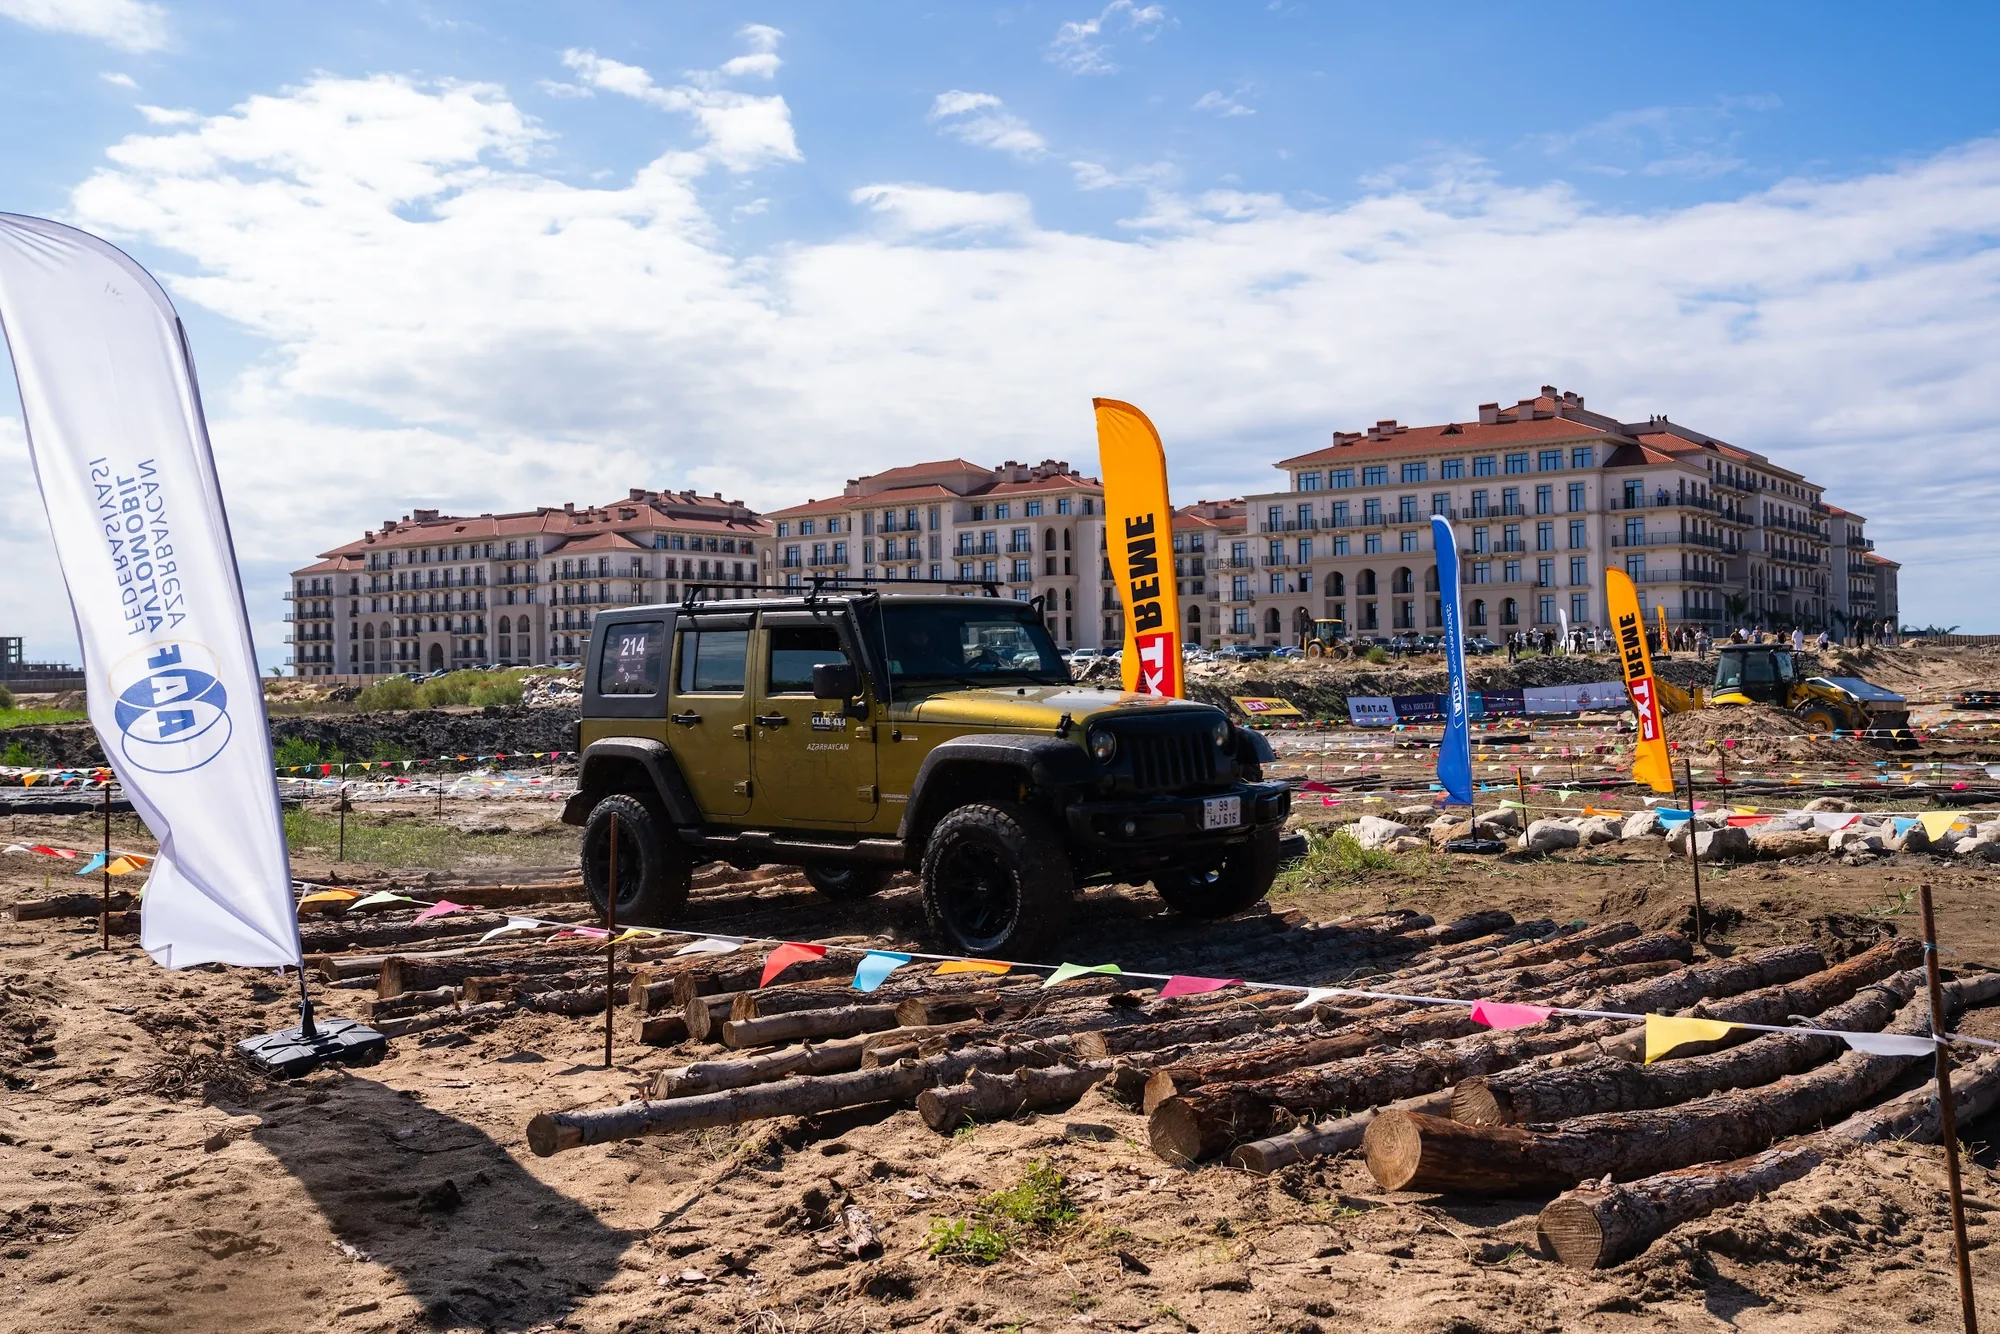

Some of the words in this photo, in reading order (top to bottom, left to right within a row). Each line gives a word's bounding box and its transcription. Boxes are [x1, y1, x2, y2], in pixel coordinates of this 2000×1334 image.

[621, 637, 645, 656] 214
[1243, 701, 1291, 710] EXTREME
[812, 717, 831, 725] CLUB
[1219, 801, 1228, 811] 99
[1210, 814, 1221, 826] HJ
[1224, 813, 1237, 824] 616
